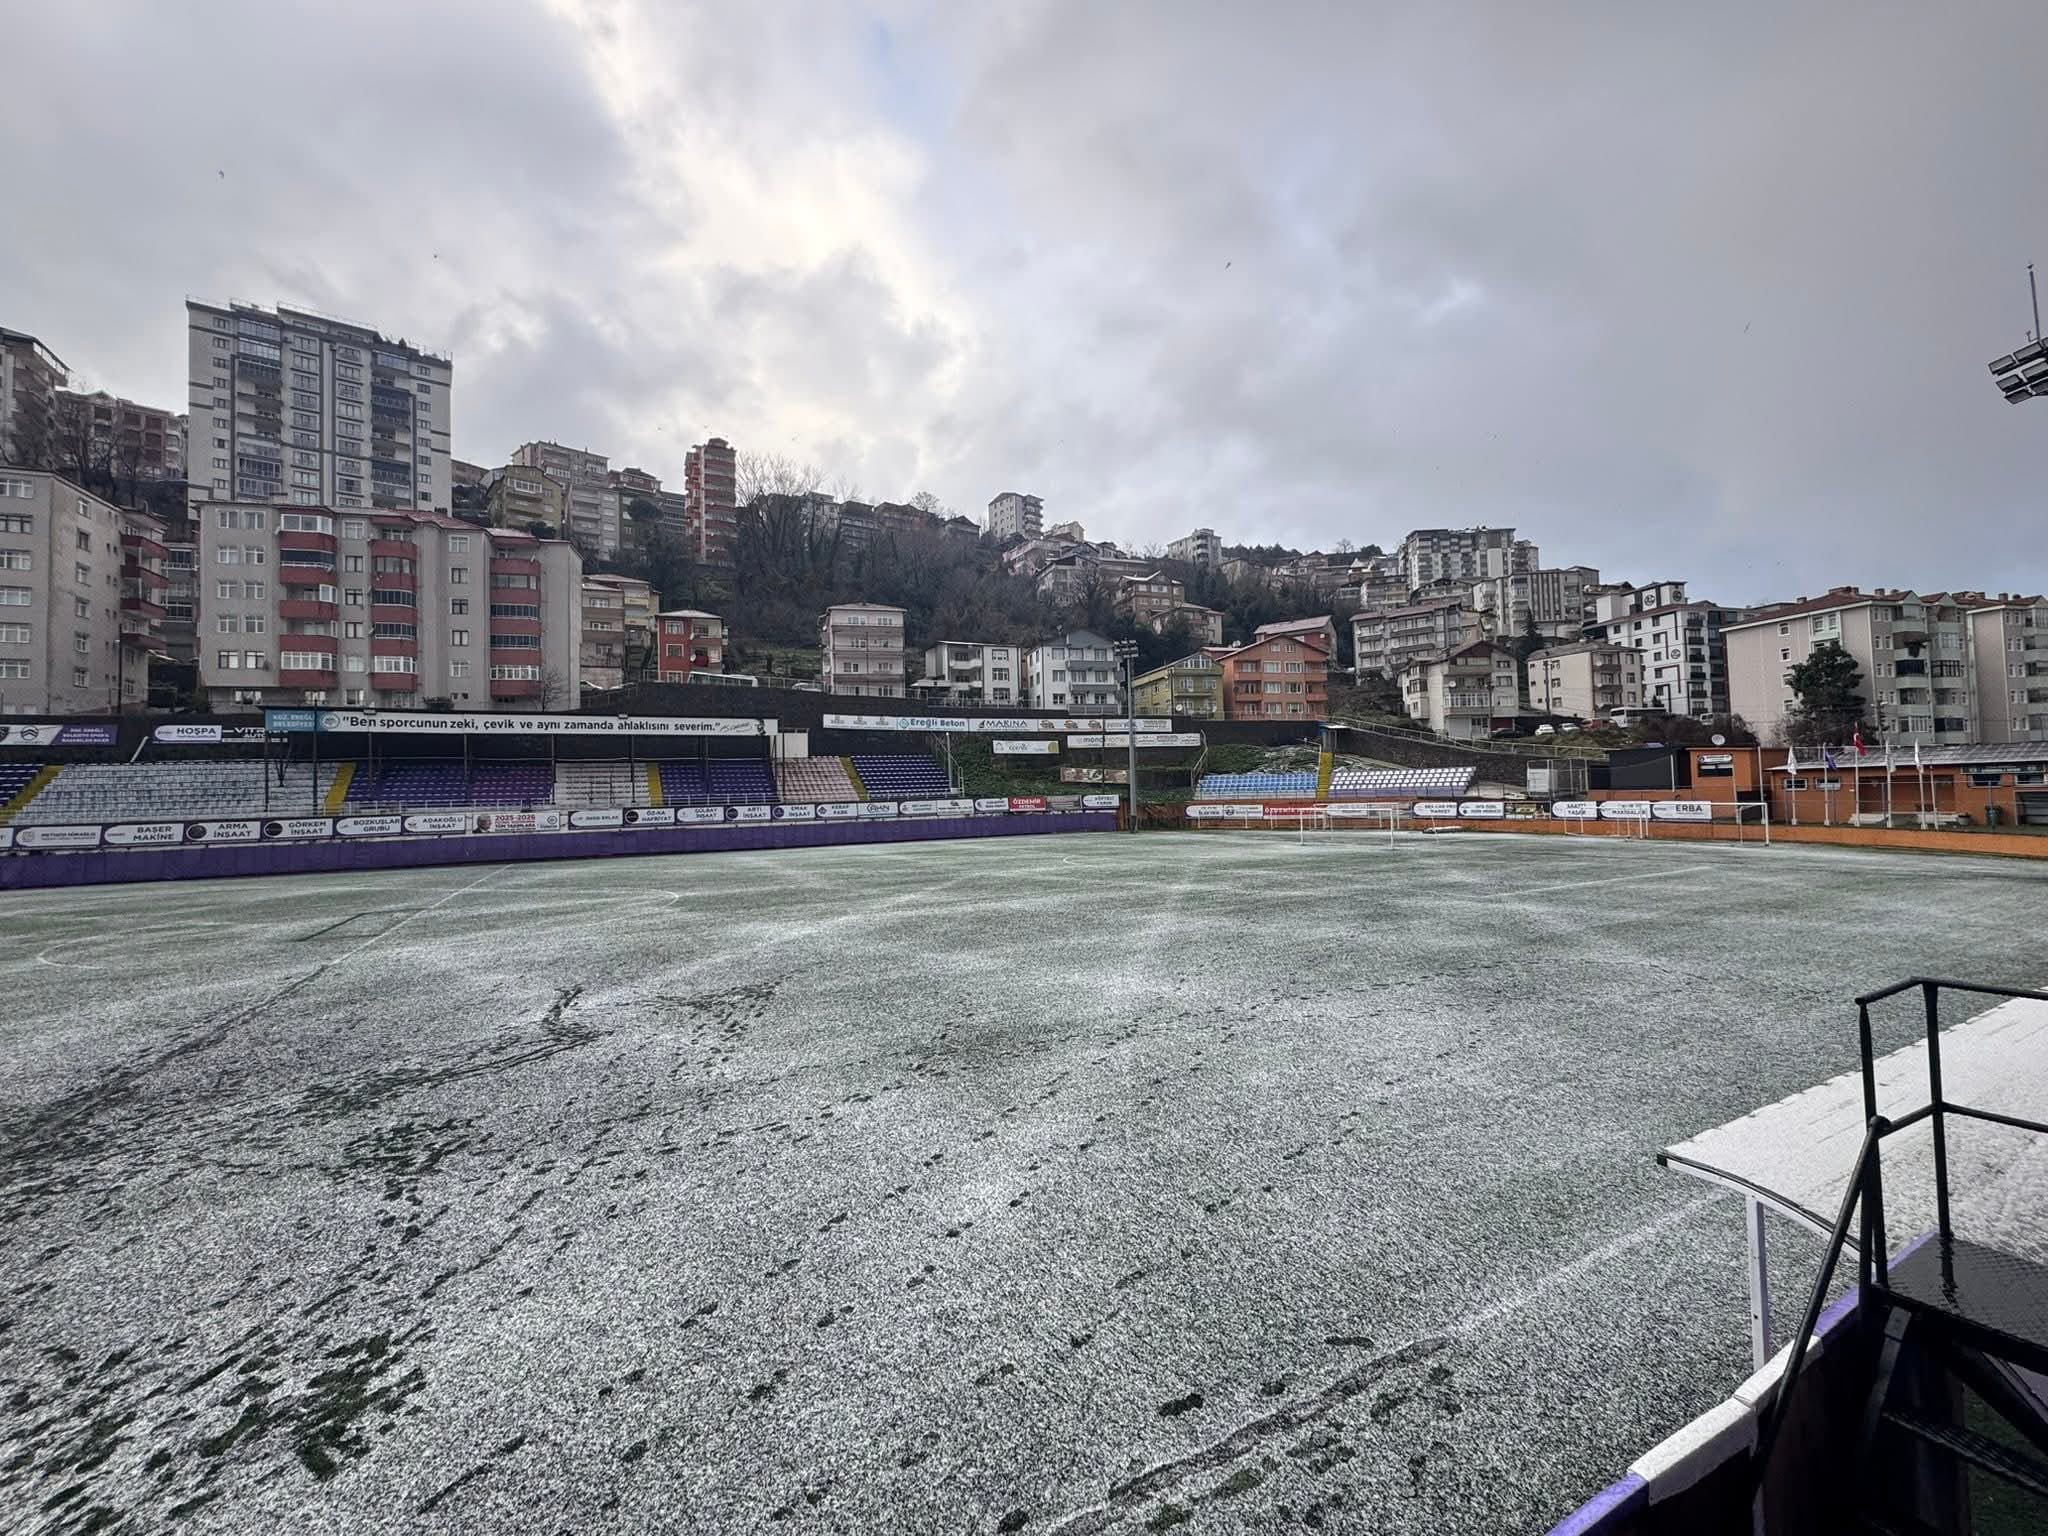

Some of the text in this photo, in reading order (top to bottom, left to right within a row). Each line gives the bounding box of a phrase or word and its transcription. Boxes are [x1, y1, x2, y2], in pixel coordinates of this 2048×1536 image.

[380, 718, 448, 729] sporcunun
[450, 718, 479, 731] zeki,
[483, 719, 515, 731] çevik
[519, 721, 533, 729] ve
[536, 721, 560, 731] aynı
[564, 720, 614, 730] zamanda
[617, 721, 670, 731] ahlaklısını
[910, 719, 966, 729] Ereğli Beton
[176, 727, 217, 736] HOŞPA
[1012, 796, 1041, 804] ÖZDEMİR
[1676, 804, 1703, 812] ERBA
[132, 833, 175, 841] MAKİNE
[213, 830, 252, 838] İNŞAAT
